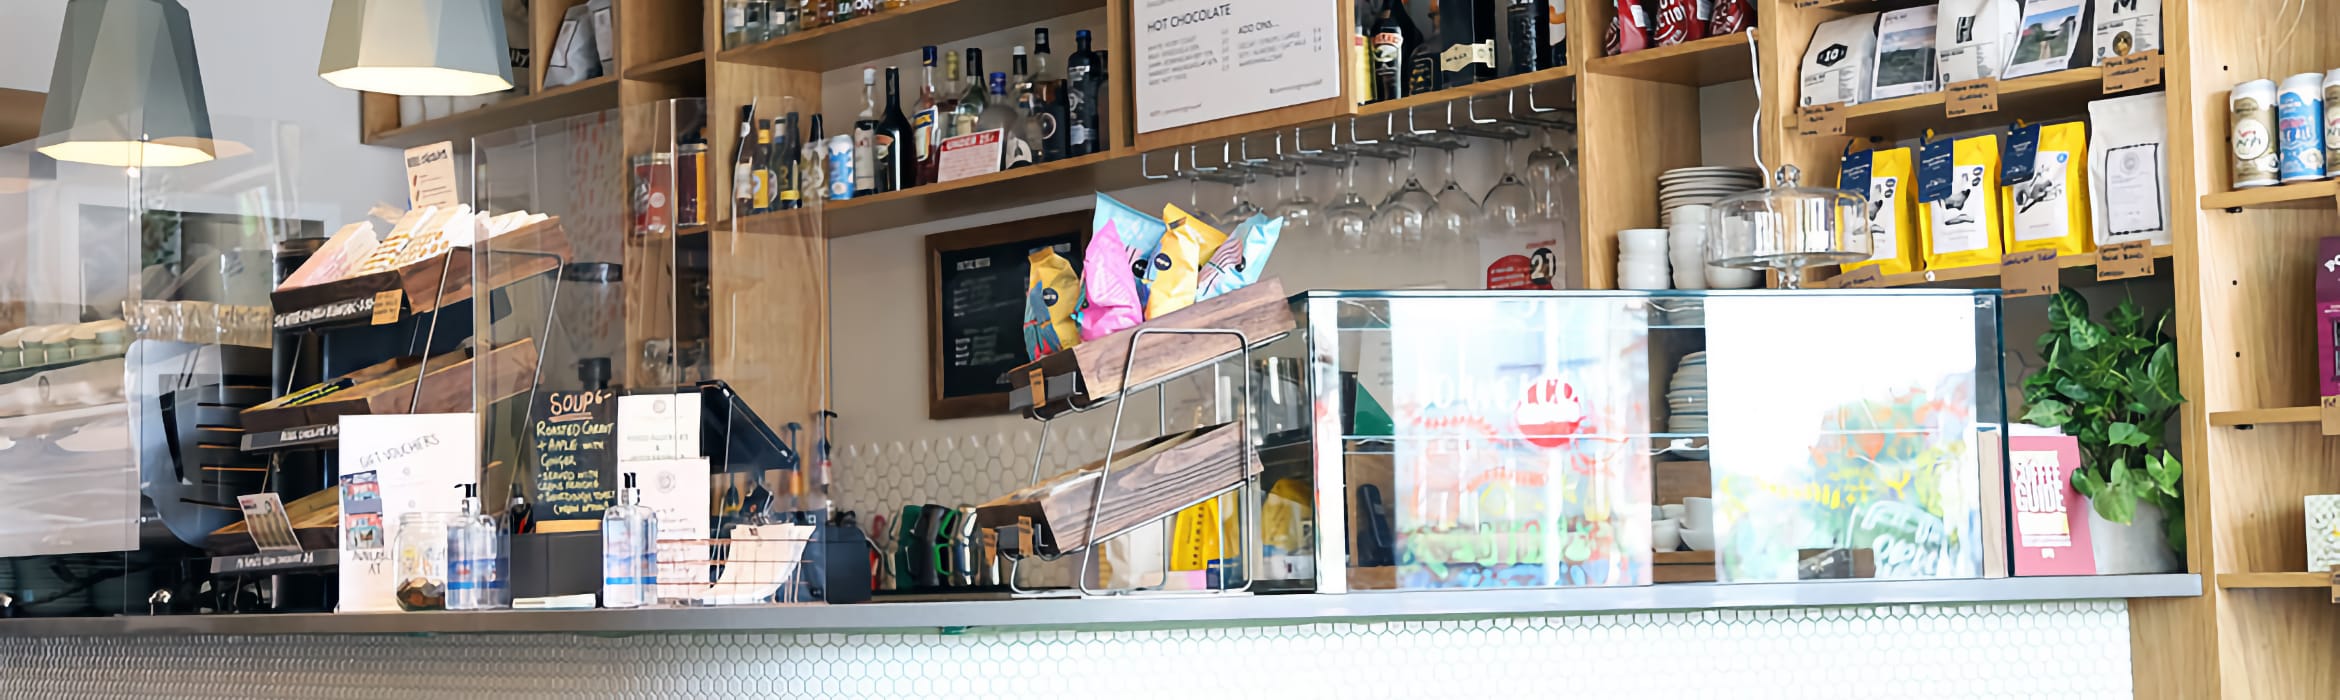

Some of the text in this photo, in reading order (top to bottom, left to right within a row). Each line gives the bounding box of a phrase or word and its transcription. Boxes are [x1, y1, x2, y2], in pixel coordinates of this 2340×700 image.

[1147, 4, 1232, 33] HOT CHOCOLATE
[1530, 252, 1554, 280] 21
[550, 392, 594, 415] SOUP
[536, 420, 581, 437] ROASTED
[2015, 480, 2067, 513] GUIDE
